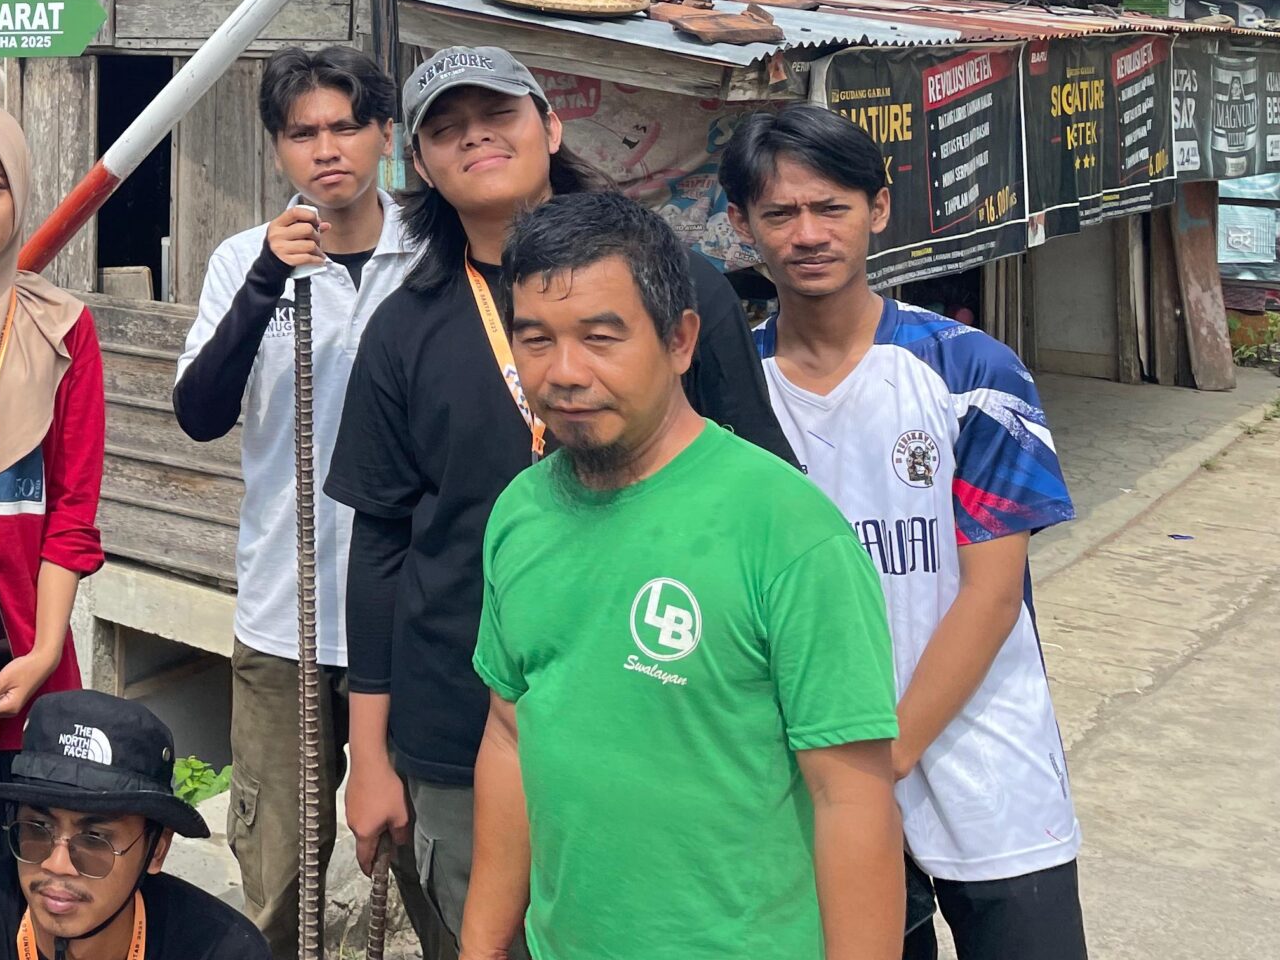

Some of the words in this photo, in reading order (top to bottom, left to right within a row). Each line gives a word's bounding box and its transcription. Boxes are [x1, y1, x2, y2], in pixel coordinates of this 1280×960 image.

[20, 35, 52, 48] 2025
[418, 57, 447, 93] NEW
[446, 53, 497, 72] YORK
[927, 64, 966, 104] REVOLUSI
[965, 52, 993, 88] KRETEK
[840, 89, 867, 100] GUDANG
[867, 87, 891, 98] GARAM
[1216, 101, 1256, 129] MAGNUM
[623, 654, 688, 686] Swalayan
[73, 723, 93, 738] THE
[58, 733, 90, 749] NORTH
[63, 745, 88, 759] FACE
